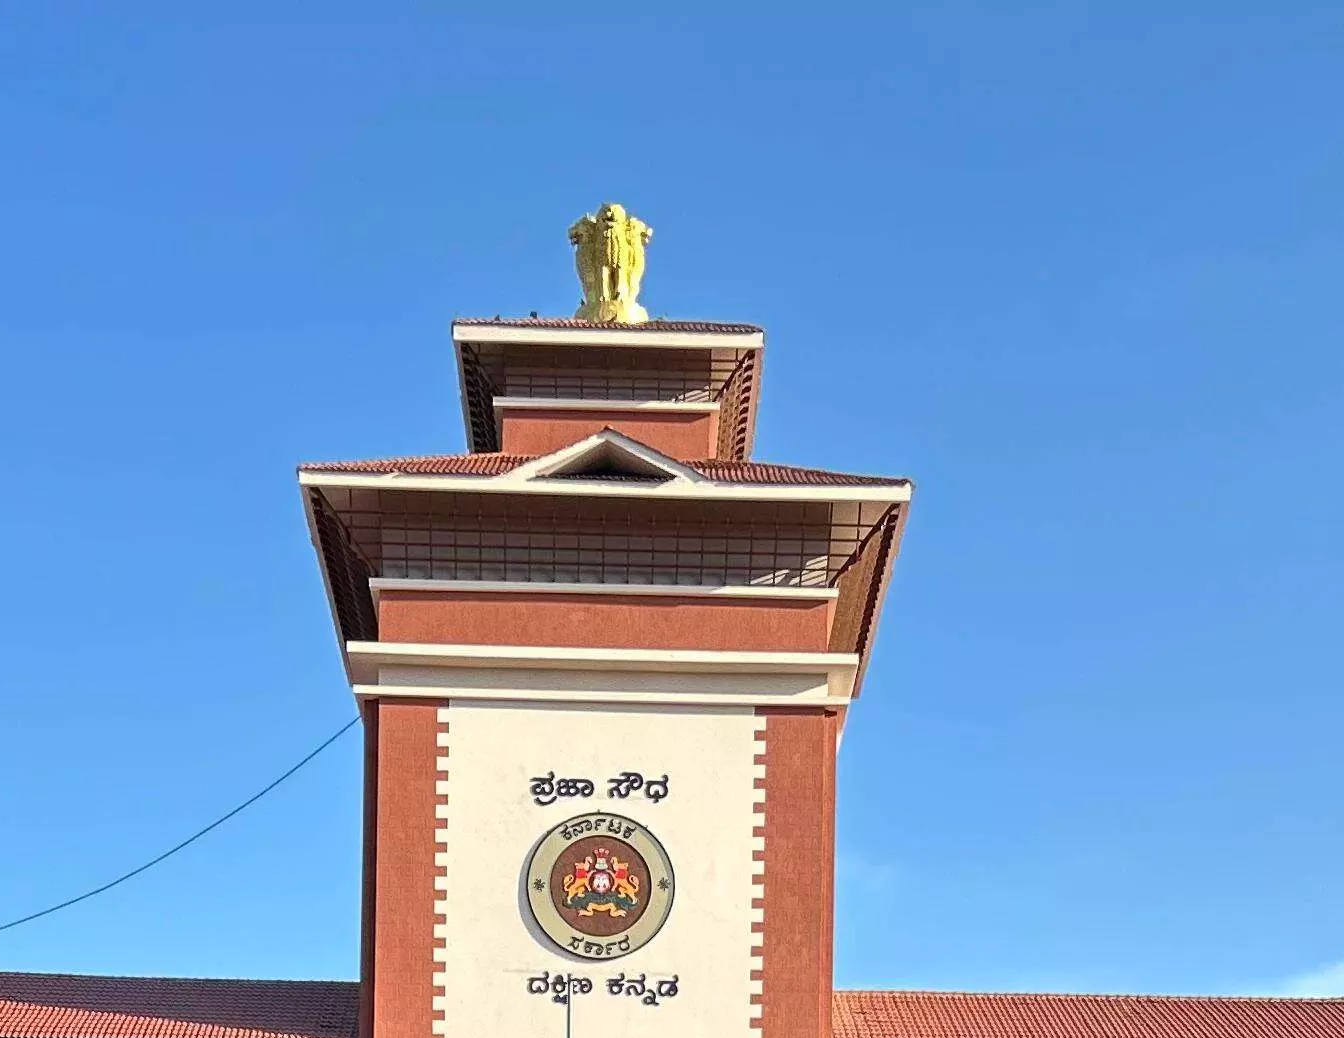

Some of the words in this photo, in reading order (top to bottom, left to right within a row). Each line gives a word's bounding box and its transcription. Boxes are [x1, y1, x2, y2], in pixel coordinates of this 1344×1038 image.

[530, 771, 594, 805] ಪ್ರಜಾ
[606, 772, 669, 803] ಸೌಧ
[560, 818, 637, 840] ಕರ್ನಾಟಕ
[567, 934, 630, 956] ಸರ್ಕಾರ
[527, 971, 593, 1004] ದಕ್ಷಿಣ
[606, 972, 679, 1006] ಕನ್ನಡ
